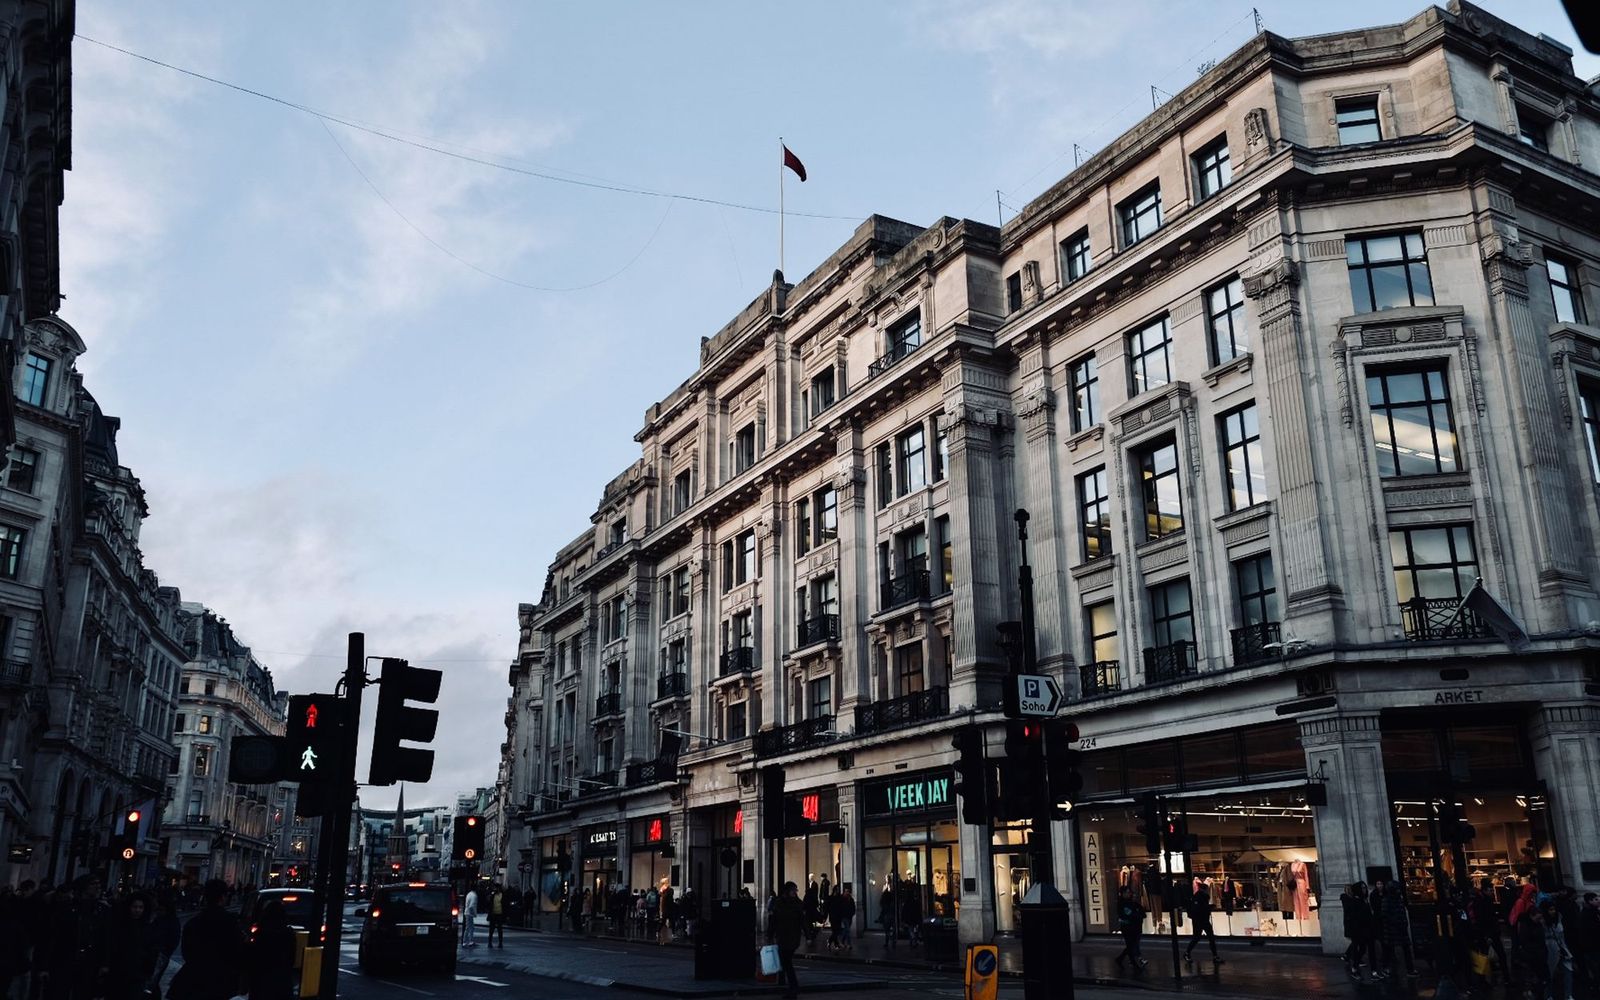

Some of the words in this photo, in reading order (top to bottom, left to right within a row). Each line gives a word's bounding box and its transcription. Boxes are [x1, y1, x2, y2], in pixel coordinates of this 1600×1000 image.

[1027, 681, 1036, 696] P
[1435, 690, 1483, 704] ARKET
[1021, 700, 1046, 712] Soho
[1080, 738, 1096, 749] 224
[1088, 834, 1101, 922] ARKET
